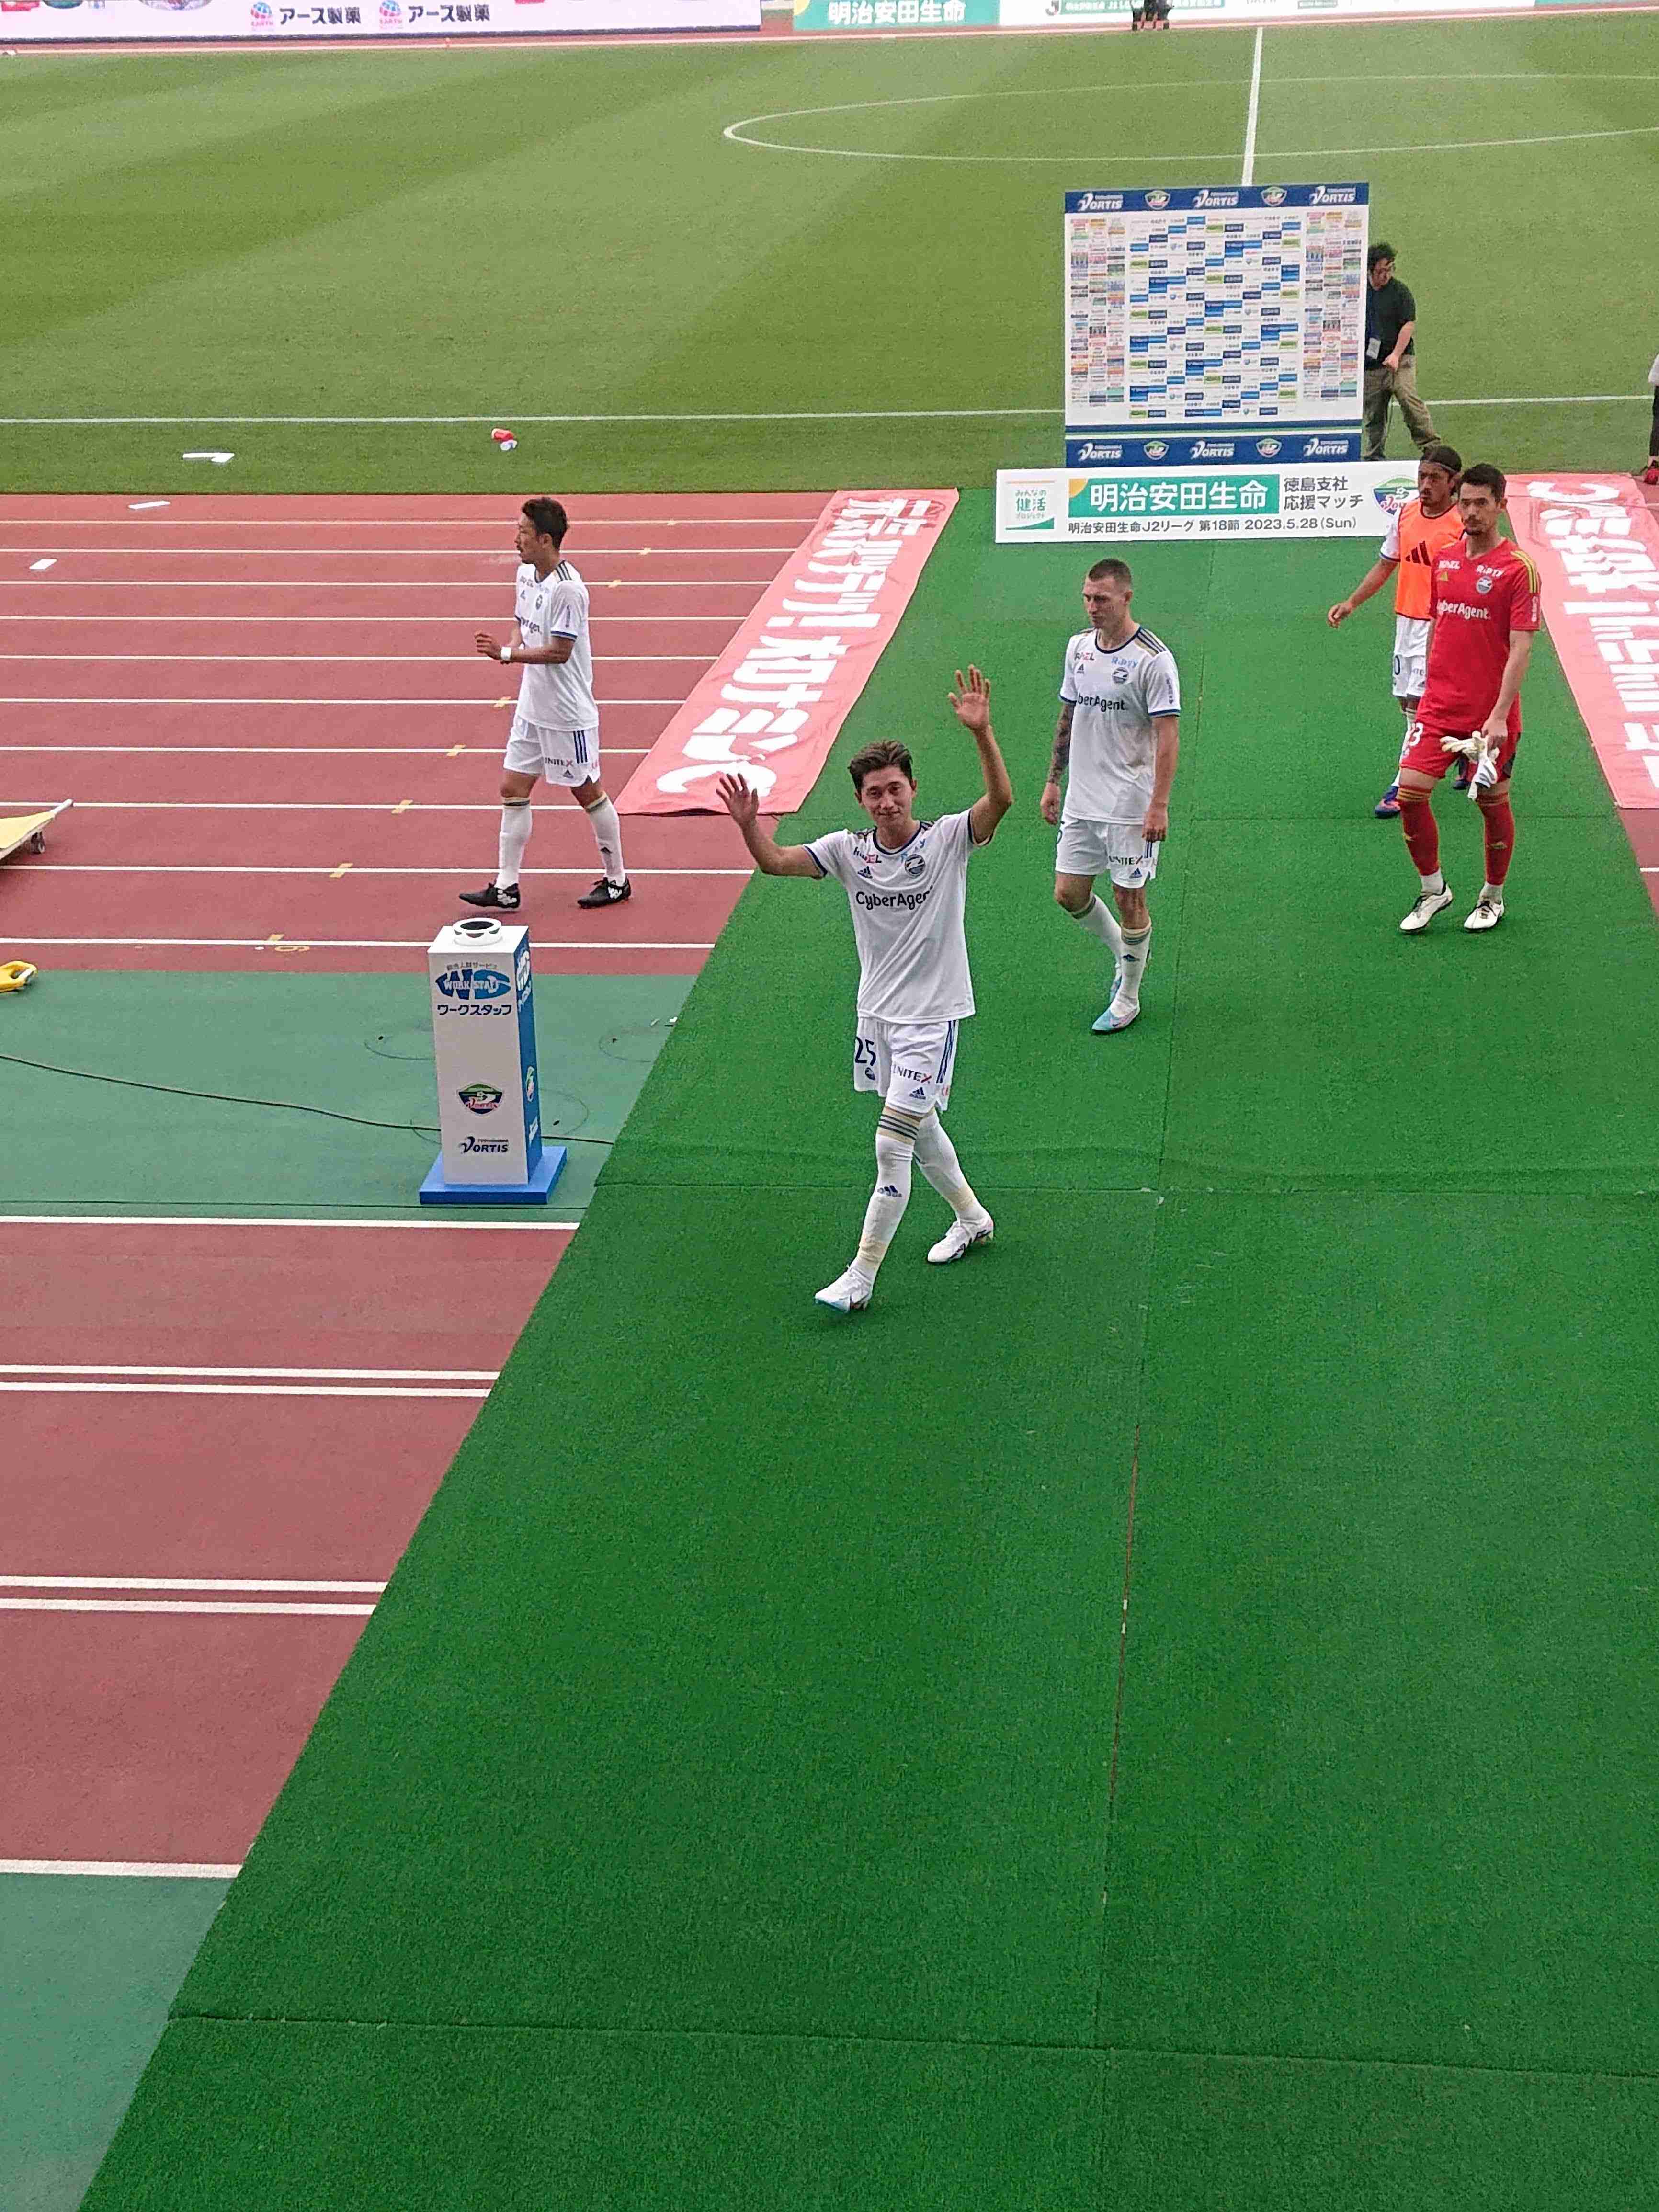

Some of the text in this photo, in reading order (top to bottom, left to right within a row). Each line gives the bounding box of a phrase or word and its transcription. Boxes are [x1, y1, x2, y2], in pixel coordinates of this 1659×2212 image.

[279, 7, 361, 24] アース製薬
[408, 4, 490, 23] アース製薬
[828, 0, 966, 24] 明治安田生命
[1284, 476, 1348, 492] 徳島支社
[1090, 479, 1269, 512] 明治安田生命
[1284, 494, 1364, 510] 応援マッチ
[1015, 498, 1046, 511] 健活
[1068, 520, 1195, 534] 明治安田生命J2リーグ
[1199, 519, 1239, 531] 第18節
[437, 1004, 512, 1015] ワークスタッフ
[855, 1036, 876, 1067] 25
[460, 1136, 509, 1153] VORTIS
